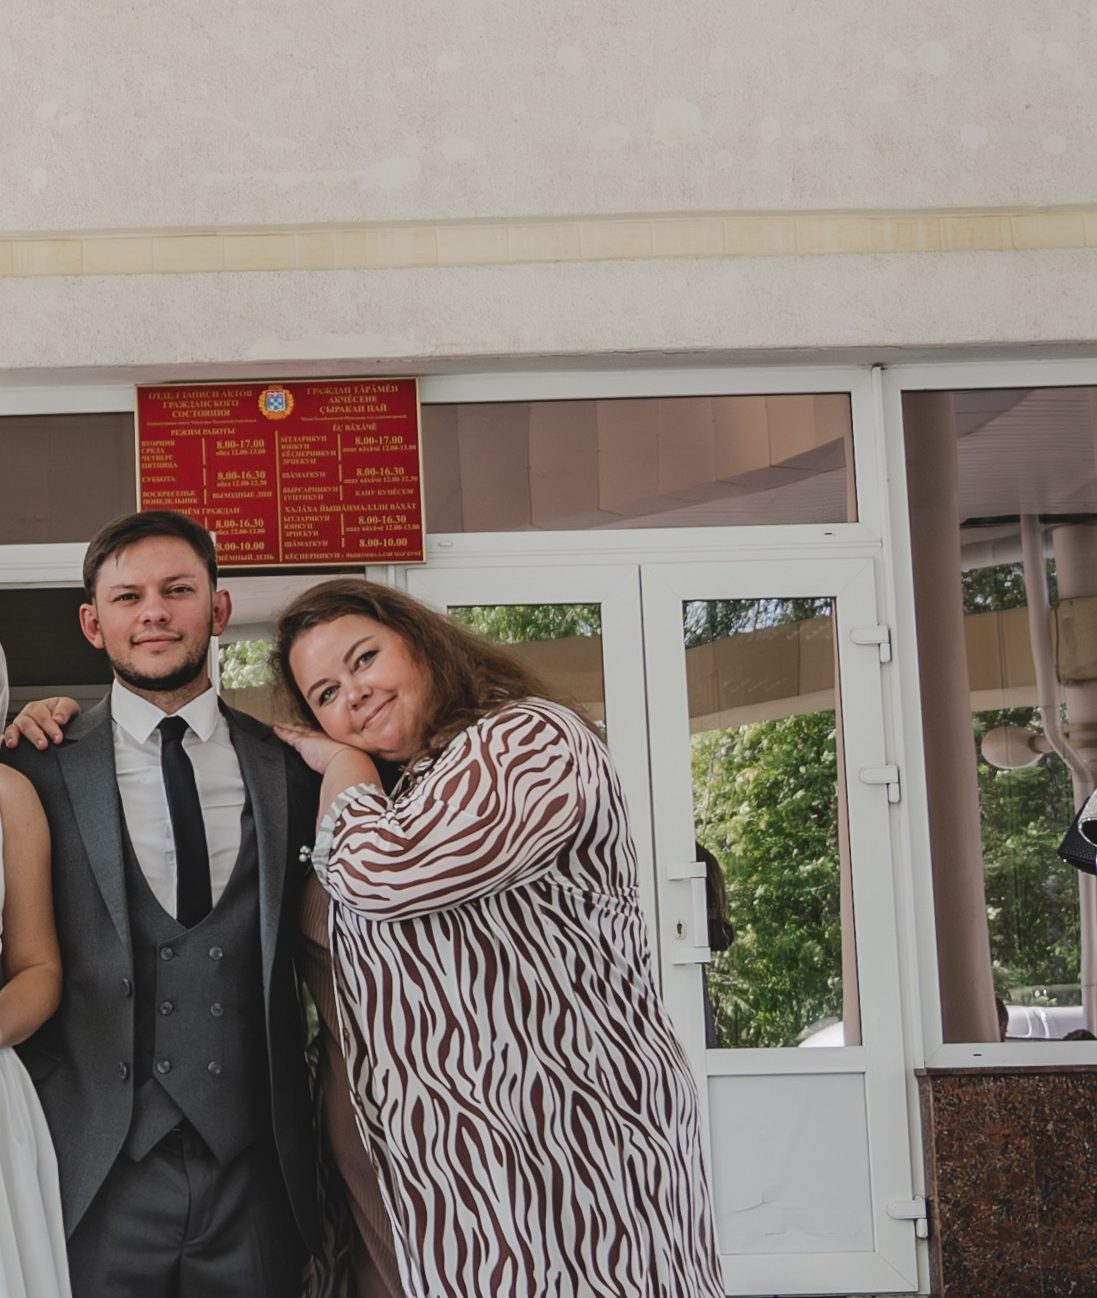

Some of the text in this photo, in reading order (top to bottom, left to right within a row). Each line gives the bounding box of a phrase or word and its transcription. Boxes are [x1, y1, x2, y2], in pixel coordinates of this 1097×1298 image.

[180, 391, 219, 399] ЗАПИСИ
[221, 390, 253, 398] АКТОВ
[307, 386, 351, 395] ГРАЖДАН
[162, 400, 239, 409] ГРАЖДАНСКОГО
[172, 409, 230, 418] СОСТОЯНИЯ
[170, 428, 235, 436] РЕЖИМ РАБОТЫ
[216, 439, 265, 449] 8.00-17.00
[355, 435, 403, 445] 8.00-17.00
[141, 454, 174, 462] ЧЕТВЕРГ
[217, 470, 266, 480] 8.00-16.30
[356, 466, 405, 477] 8.00-16.30
[212, 491, 254, 499] ВЫХОДНЫЕ
[143, 497, 198, 505] ПОНЕДЕЛЬНИК
[202, 506, 240, 515] ГРАЖДАН
[215, 518, 264, 529] 8.00-16.30
[358, 514, 407, 525] 8.00-16.30
[216, 541, 265, 551] 8.00-10.00
[359, 537, 408, 548] 8.00-10.00
